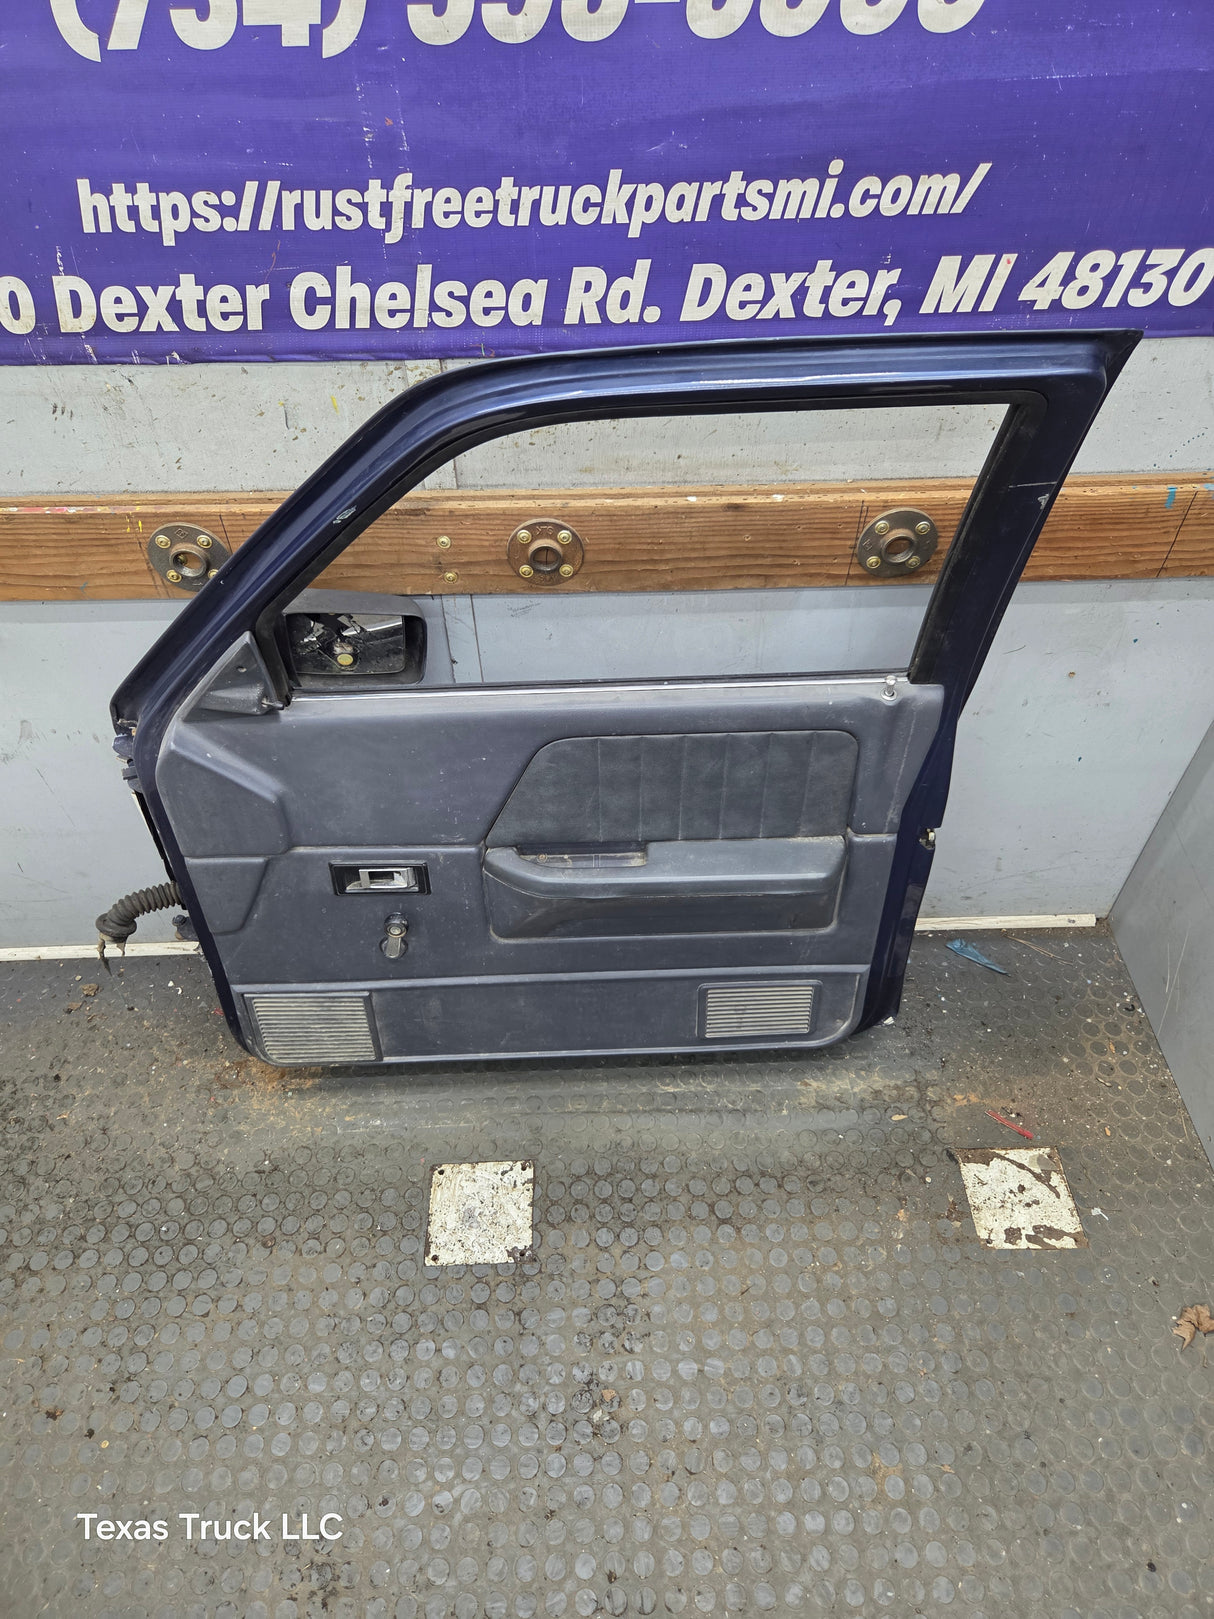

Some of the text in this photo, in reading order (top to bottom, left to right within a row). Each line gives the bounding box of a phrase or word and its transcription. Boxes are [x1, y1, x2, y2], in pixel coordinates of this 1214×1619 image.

[76, 158, 993, 246] https://rustfreetruckpartsmi.com/
[52, 264, 271, 333] Dexter
[290, 263, 549, 331] Chelsea
[563, 258, 662, 325] Rd.
[679, 259, 902, 327] Dexter,
[918, 252, 1019, 314] MI
[1018, 247, 1214, 311] 48130
